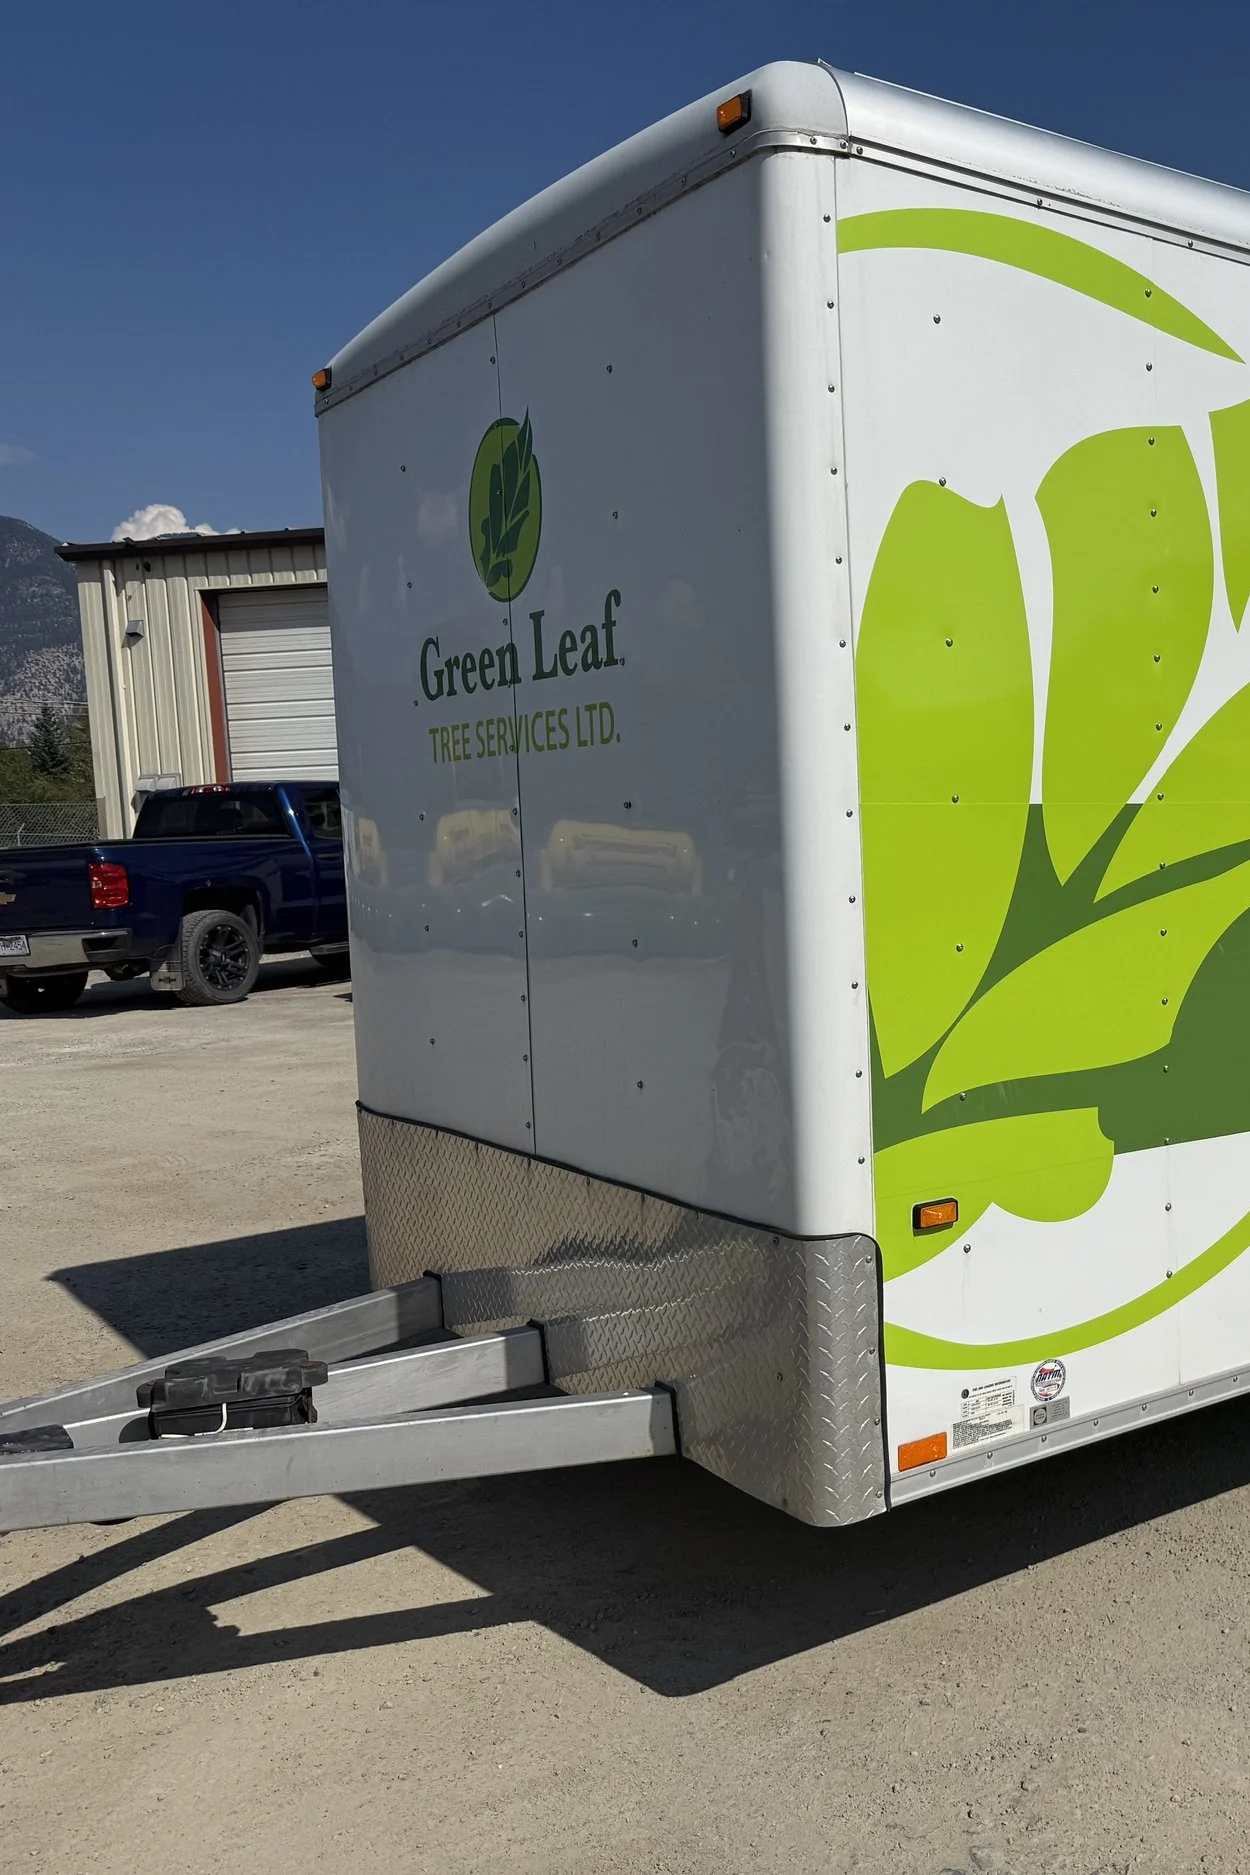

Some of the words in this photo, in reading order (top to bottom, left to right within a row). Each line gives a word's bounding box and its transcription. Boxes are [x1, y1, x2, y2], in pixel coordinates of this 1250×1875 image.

[420, 635, 522, 701] Green
[529, 588, 622, 681] Leaf
[428, 722, 472, 764] TREE
[476, 707, 570, 759] SERVICES
[575, 701, 621, 748] LTD.
